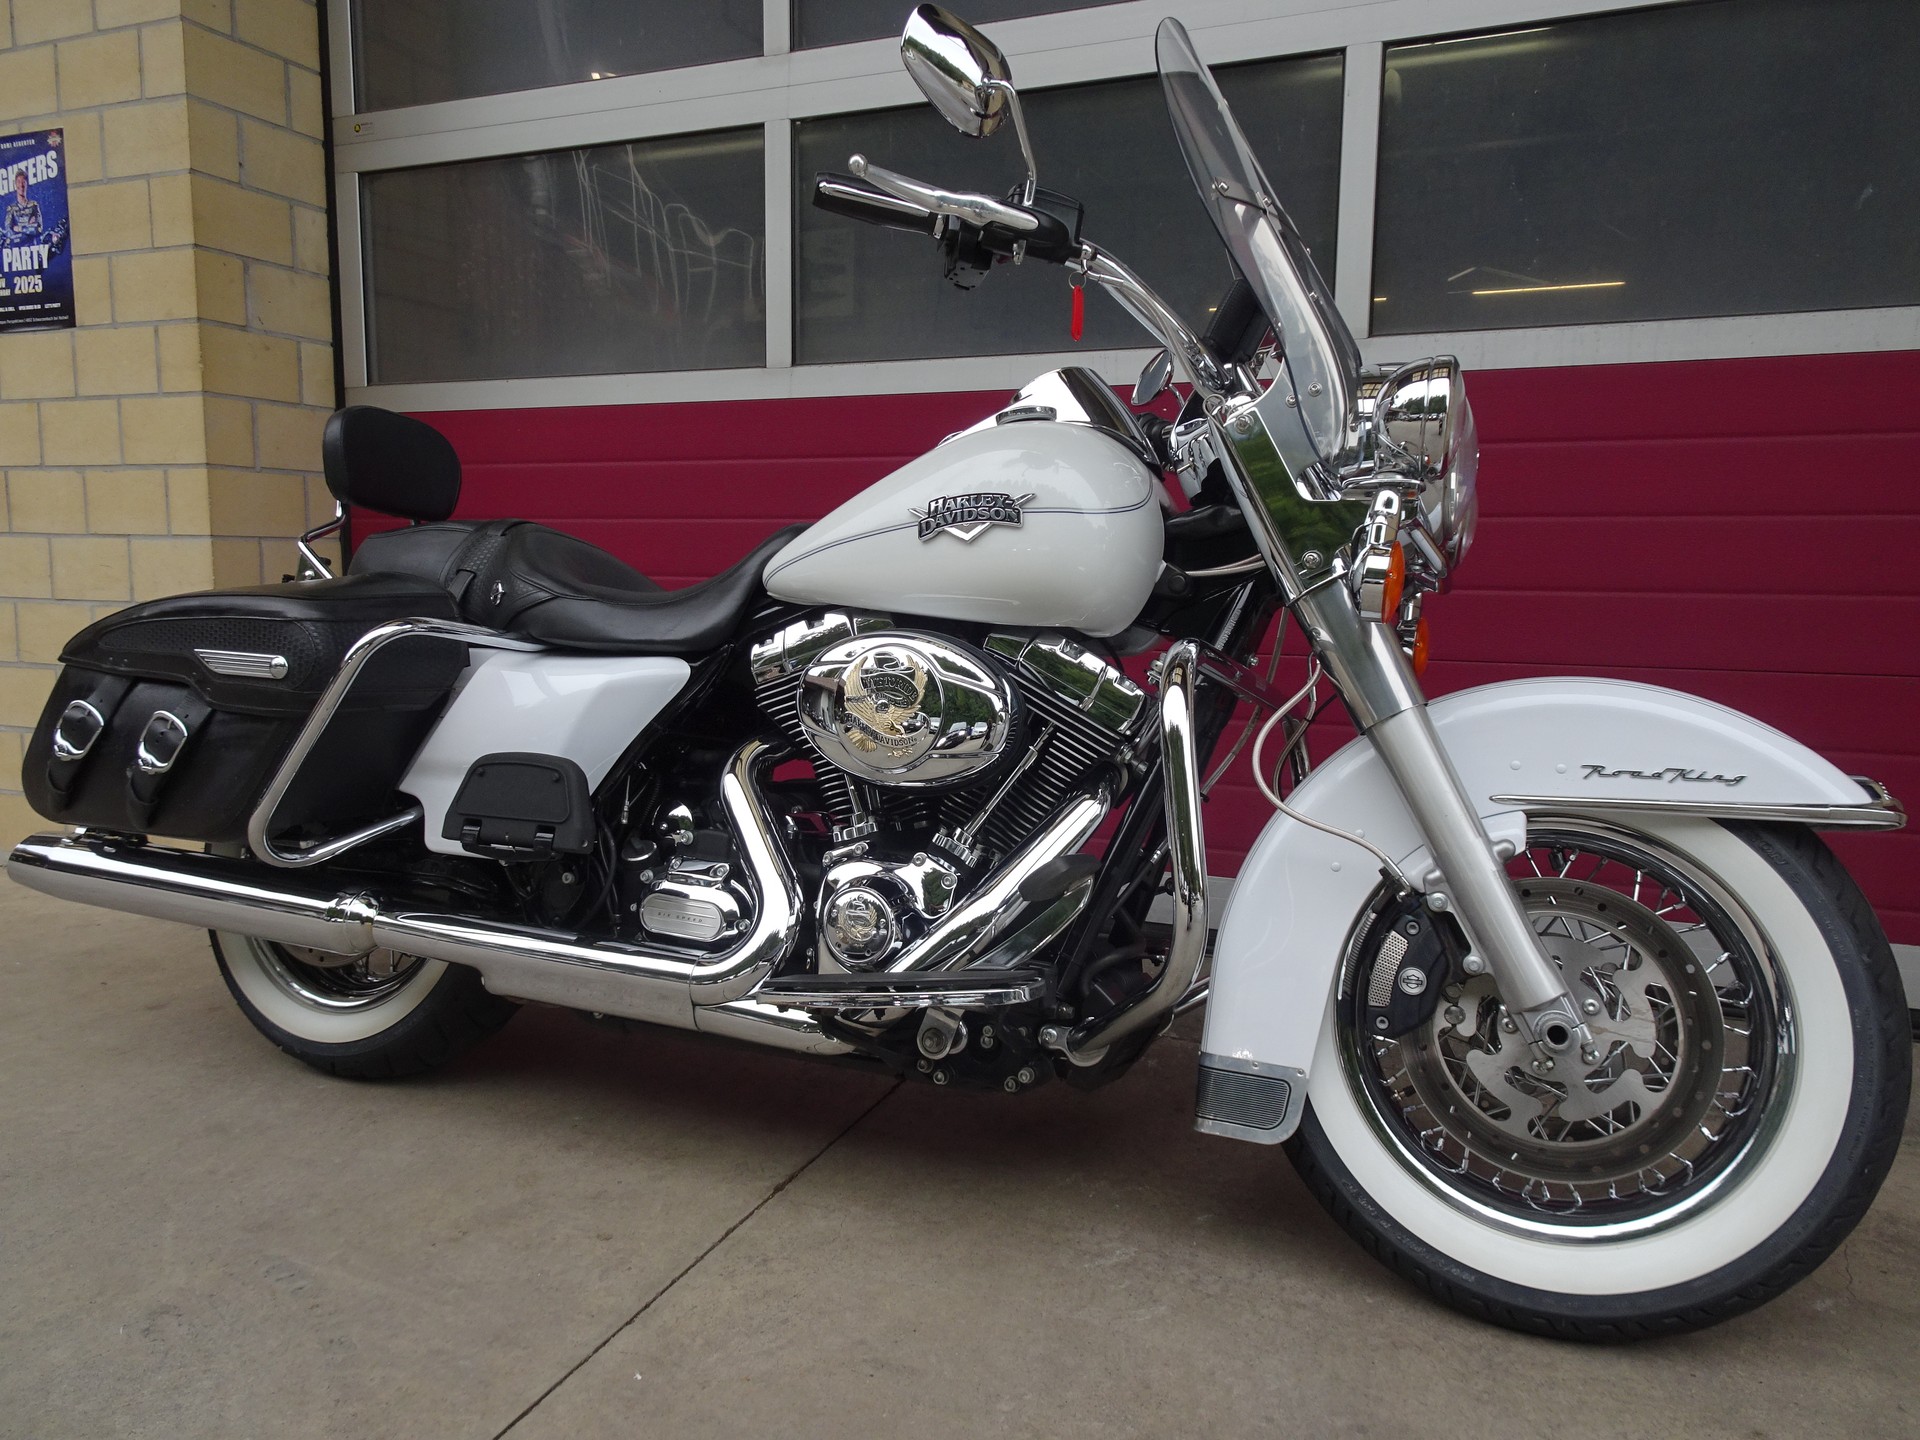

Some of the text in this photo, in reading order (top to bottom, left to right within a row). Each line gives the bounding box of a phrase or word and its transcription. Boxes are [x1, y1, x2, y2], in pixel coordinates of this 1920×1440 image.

[2, 244, 49, 272] PARTY
[14, 275, 43, 294] 2025
[929, 494, 1013, 515] HARLEY-
[920, 507, 1019, 537] DAVIDSON
